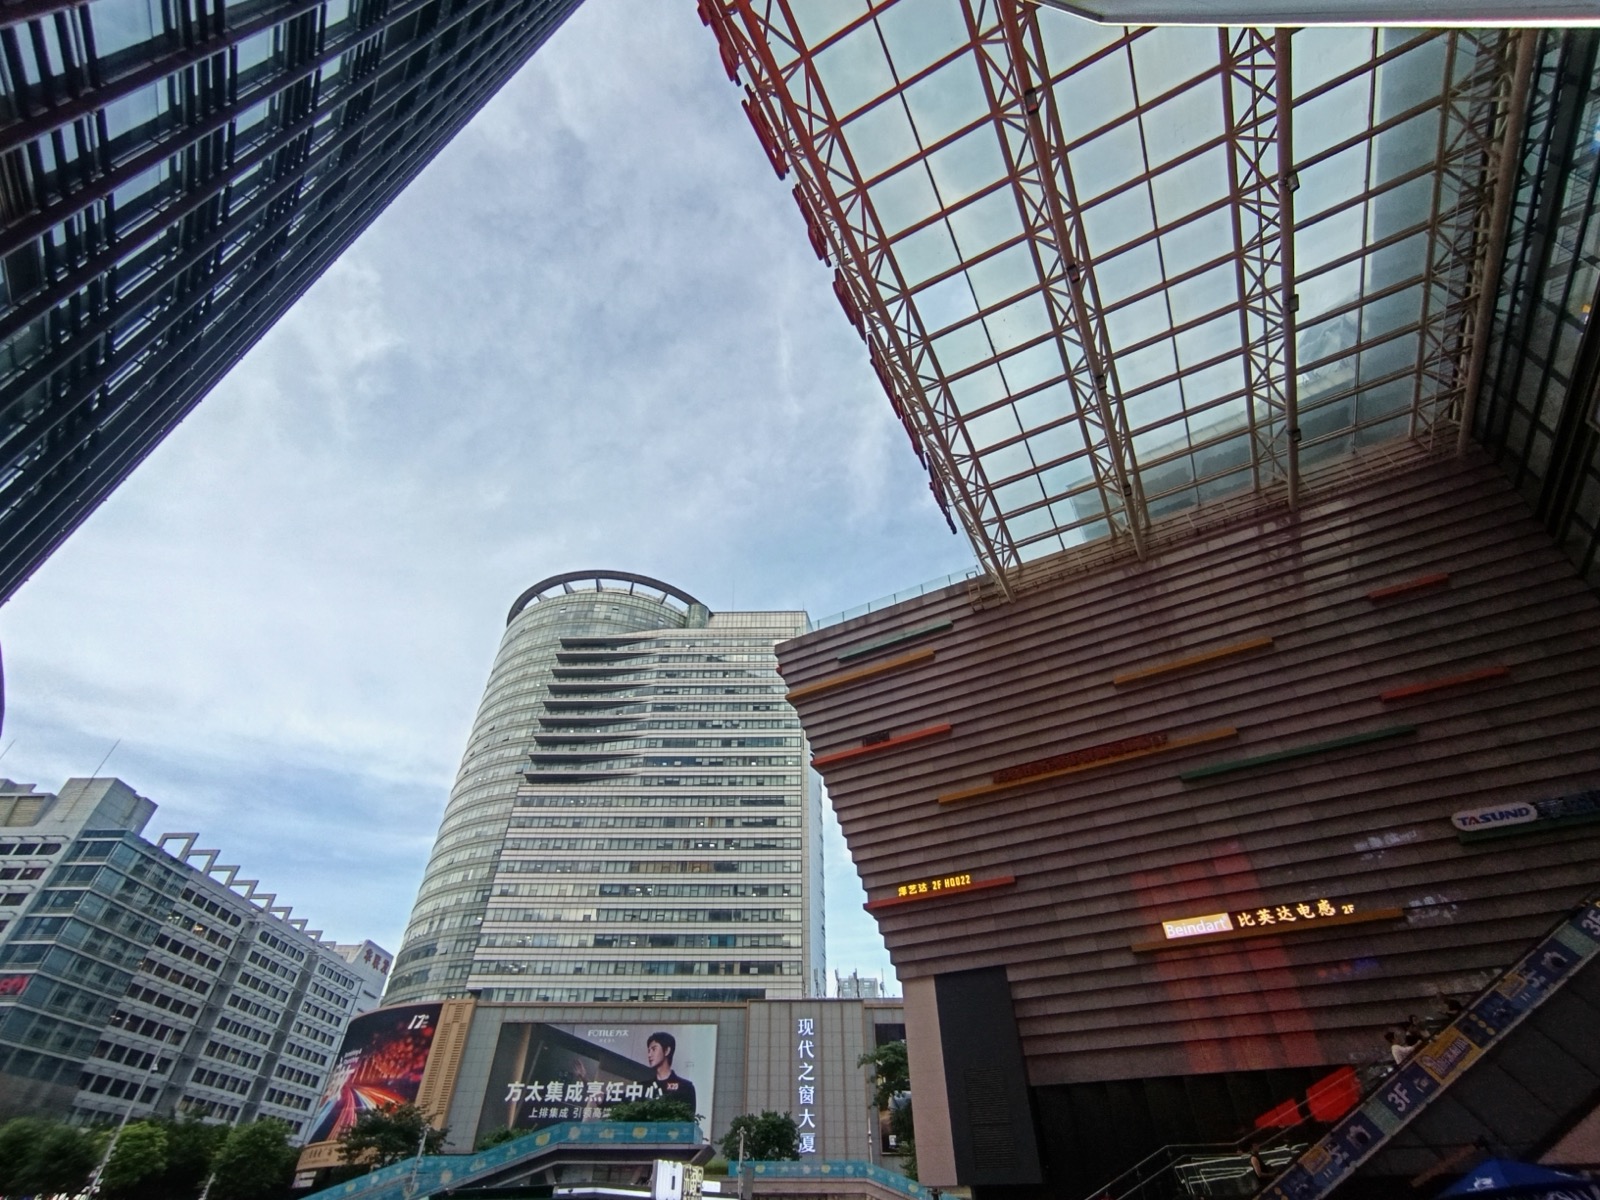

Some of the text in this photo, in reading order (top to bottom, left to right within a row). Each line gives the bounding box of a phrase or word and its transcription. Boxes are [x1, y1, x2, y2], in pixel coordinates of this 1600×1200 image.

[1457, 807, 1530, 826] TASUND
[932, 880, 941, 890] 2F
[1165, 899, 1355, 938] Beindart 比英达电感 2F
[505, 1080, 663, 1102] 方太集成烹饪中心
[797, 1018, 816, 1153] 现代之窗大厦
[1387, 1082, 1411, 1112] 3F
[528, 1107, 569, 1119] 上排集成
